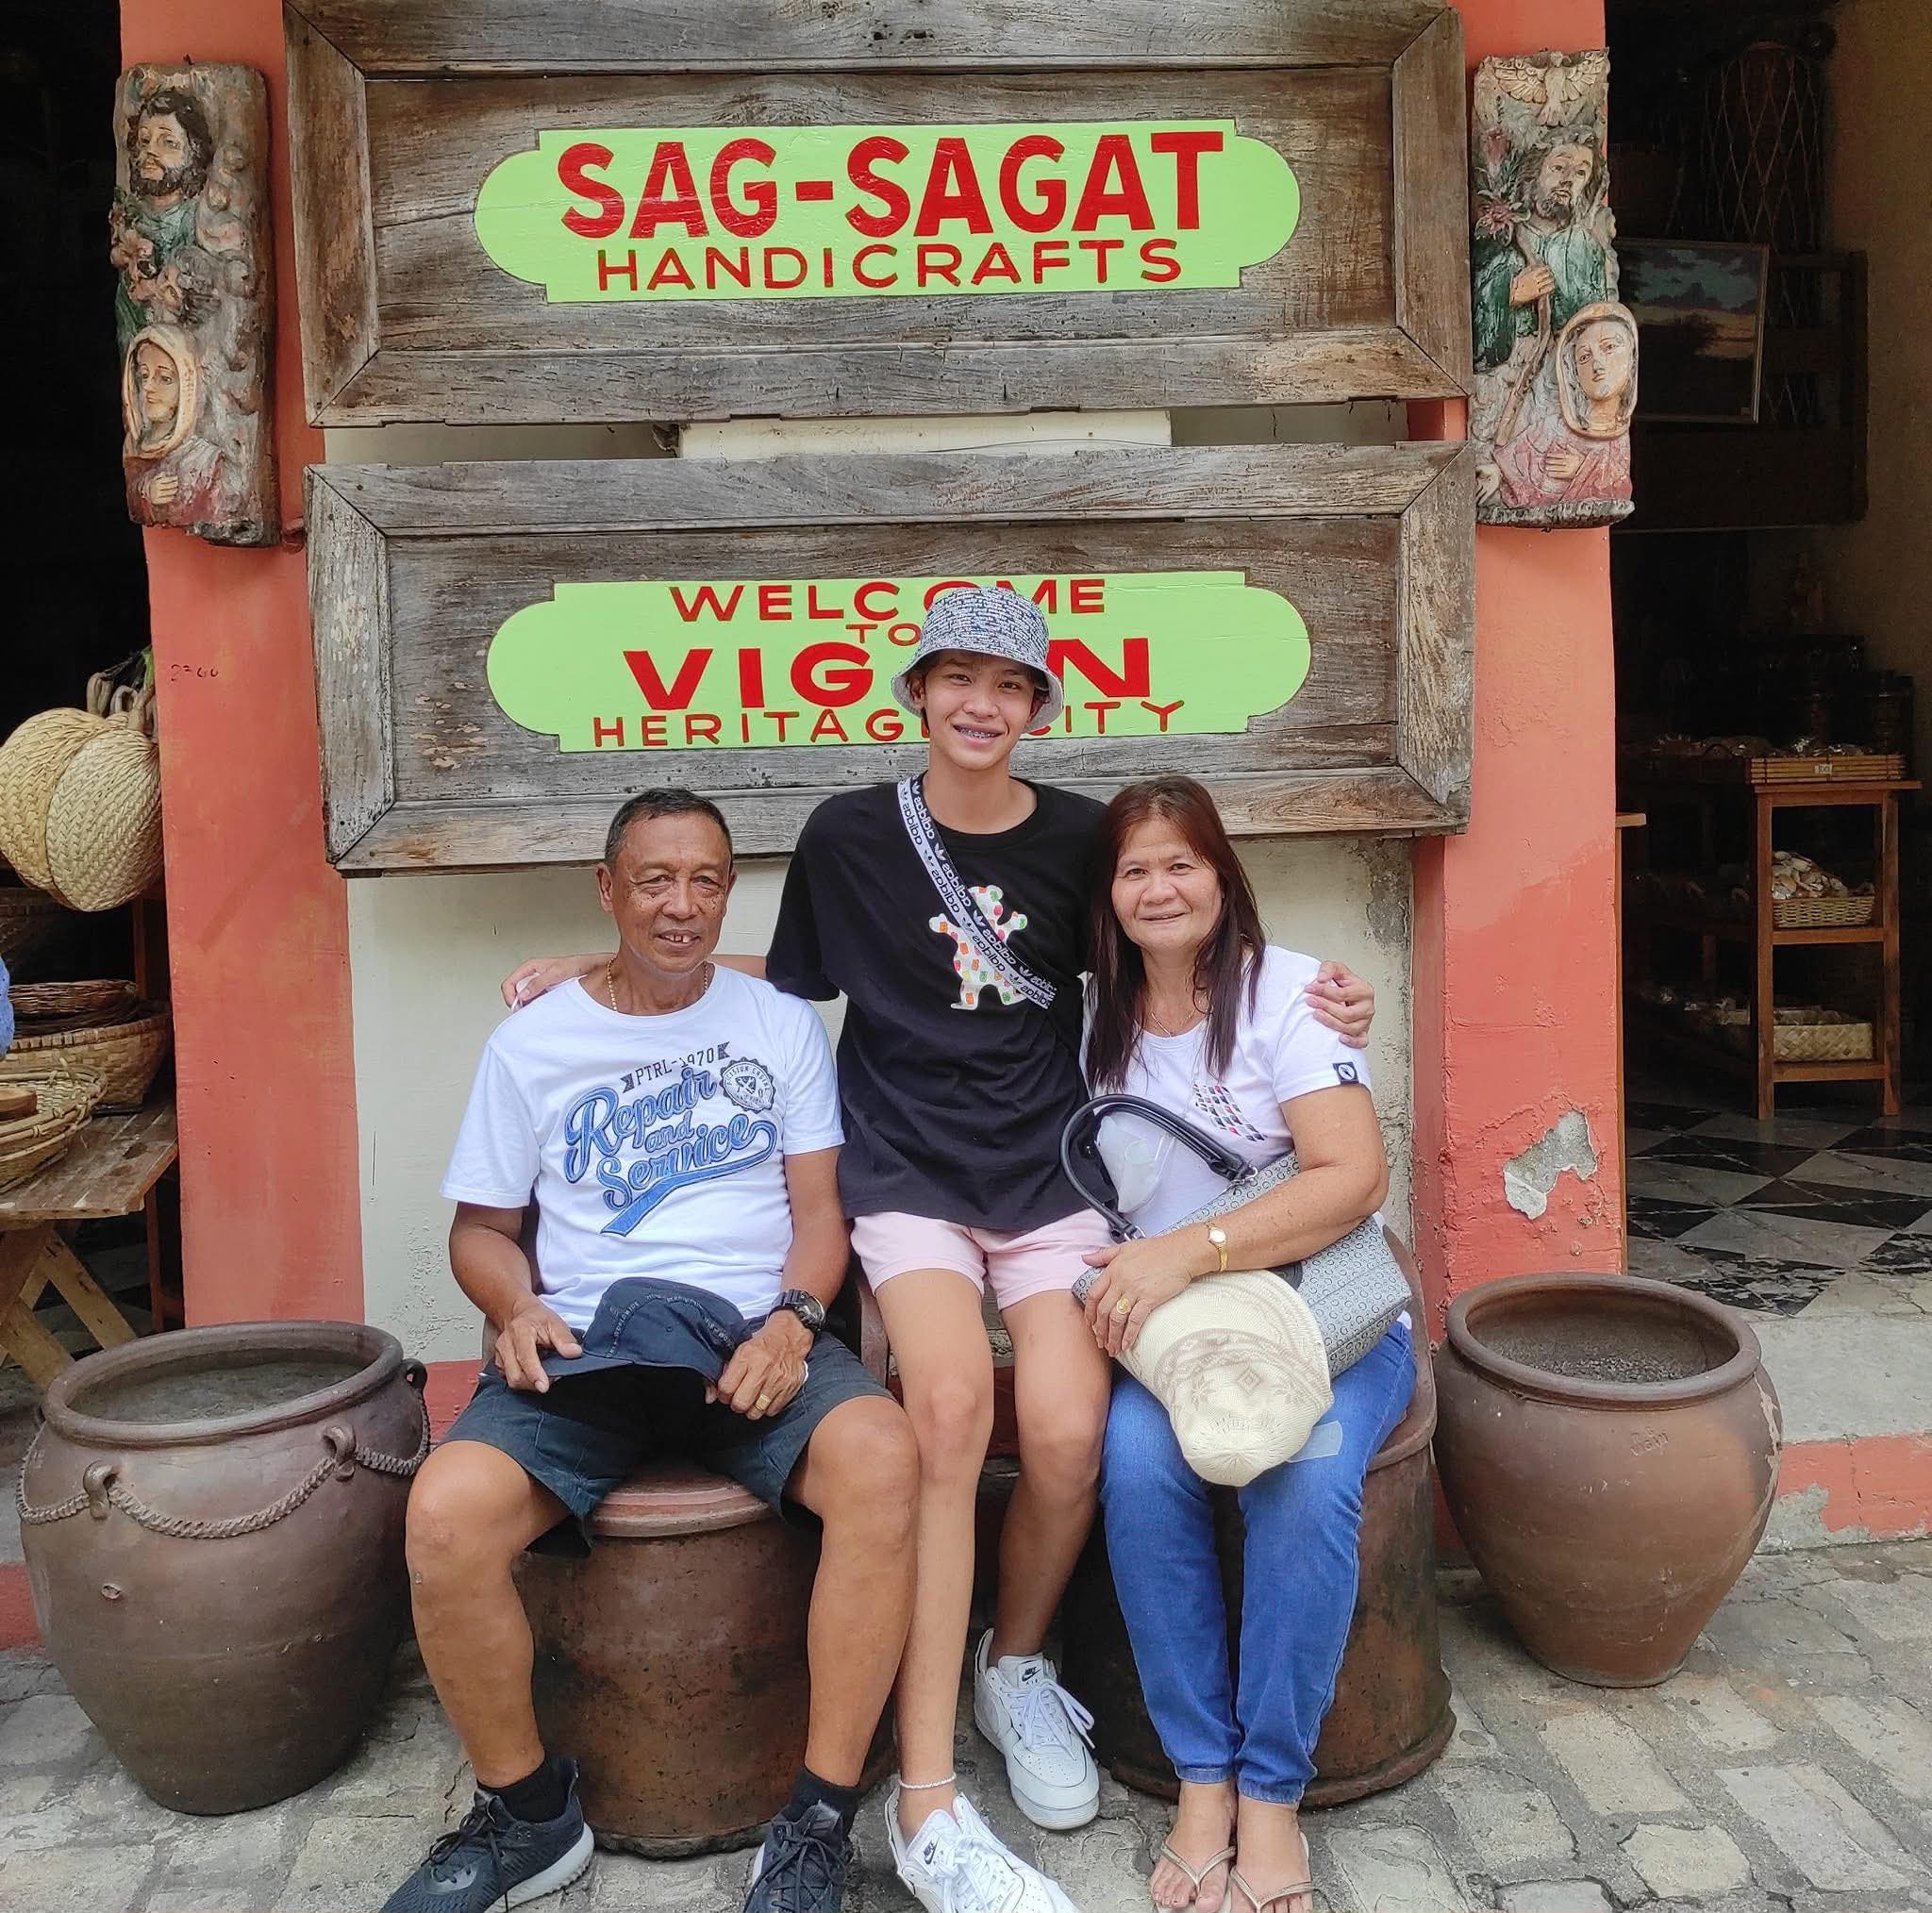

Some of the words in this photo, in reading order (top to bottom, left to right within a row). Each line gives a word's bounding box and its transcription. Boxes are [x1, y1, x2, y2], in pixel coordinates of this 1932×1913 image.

[558, 131, 1224, 239] SAG-SAGAT
[598, 239, 1182, 291] HANDICRAFTS
[846, 624, 922, 646] TO
[624, 638, 1150, 710] VIGN
[1029, 701, 1183, 737] ITY
[563, 1068, 718, 1184] Repair
[644, 1110, 694, 1153] and
[596, 1114, 752, 1211] Service
